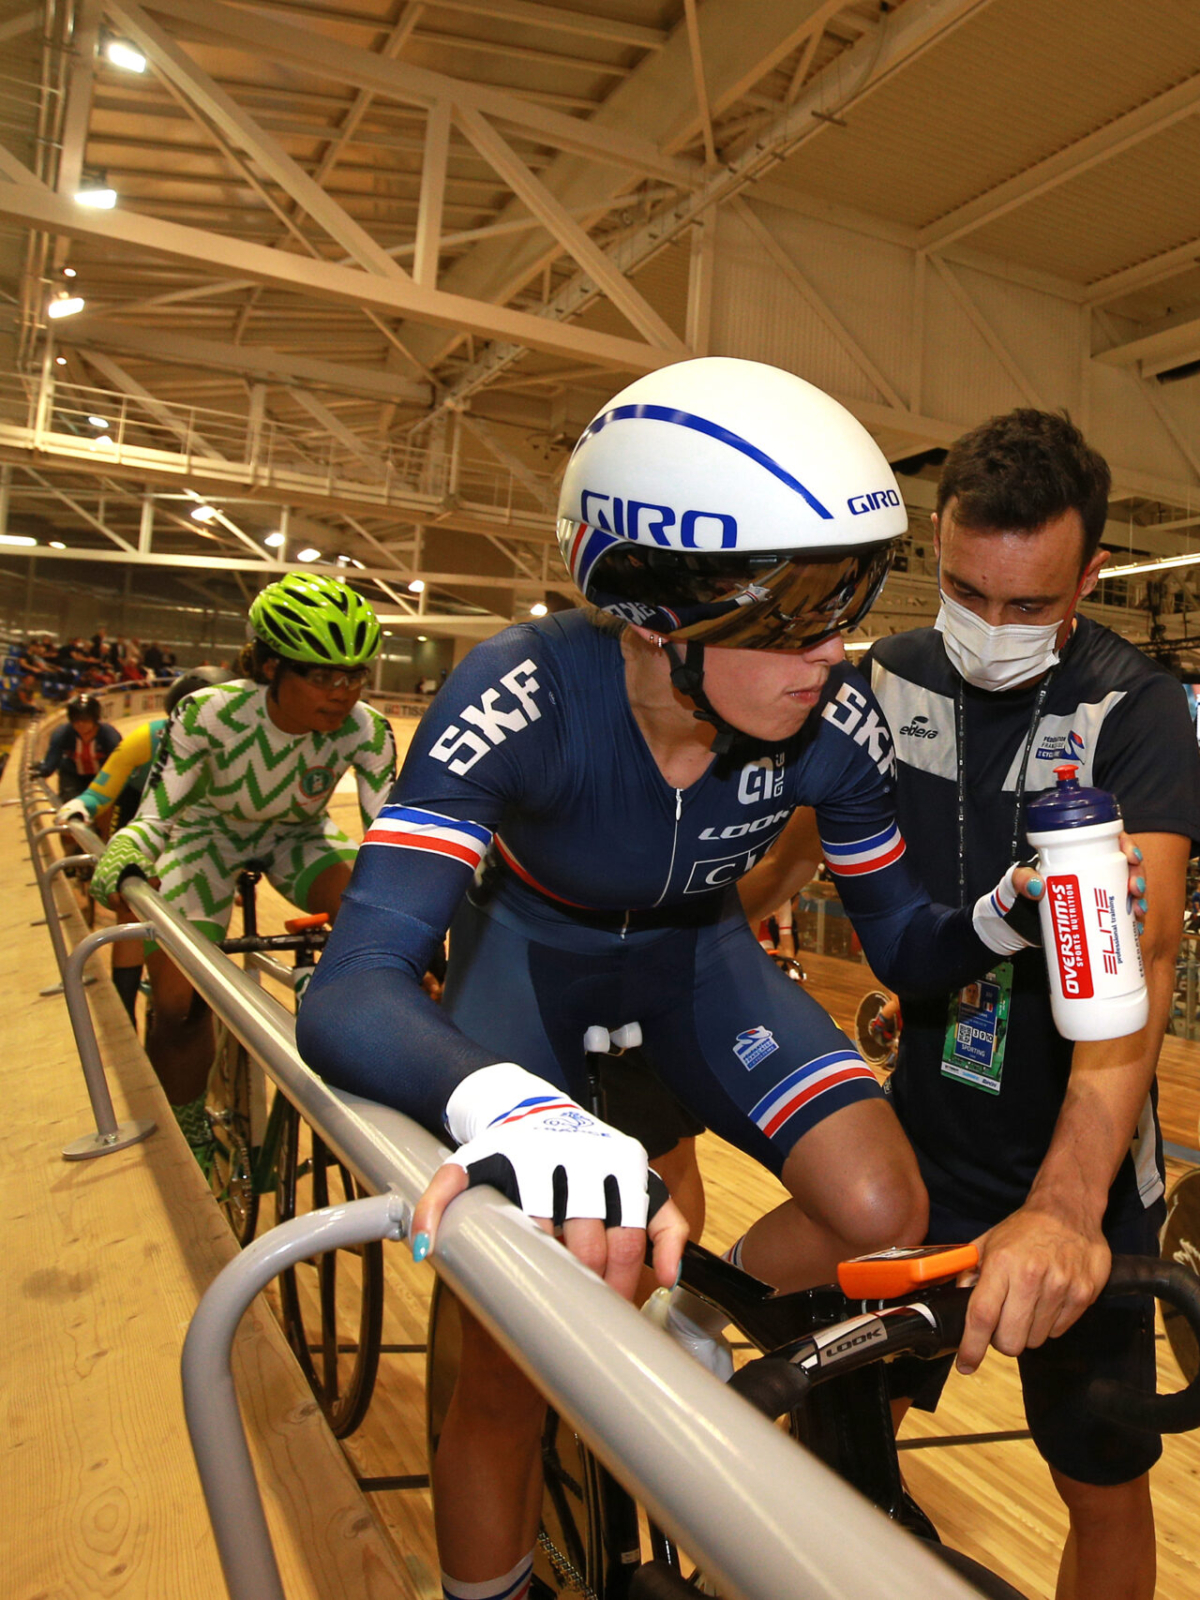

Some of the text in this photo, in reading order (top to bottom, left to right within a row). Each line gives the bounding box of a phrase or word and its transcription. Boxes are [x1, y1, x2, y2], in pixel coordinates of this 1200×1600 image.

[581, 489, 738, 549] GIRO
[846, 489, 901, 516] GIRO
[429, 659, 543, 776] SKF
[1066, 883, 1084, 968] SPORTS NUTRITION
[1093, 887, 1118, 976] ELITE
[1108, 895, 1124, 965] professional training
[961, 1043, 987, 1057] SPORTING
[825, 1327, 882, 1358] LOOK
